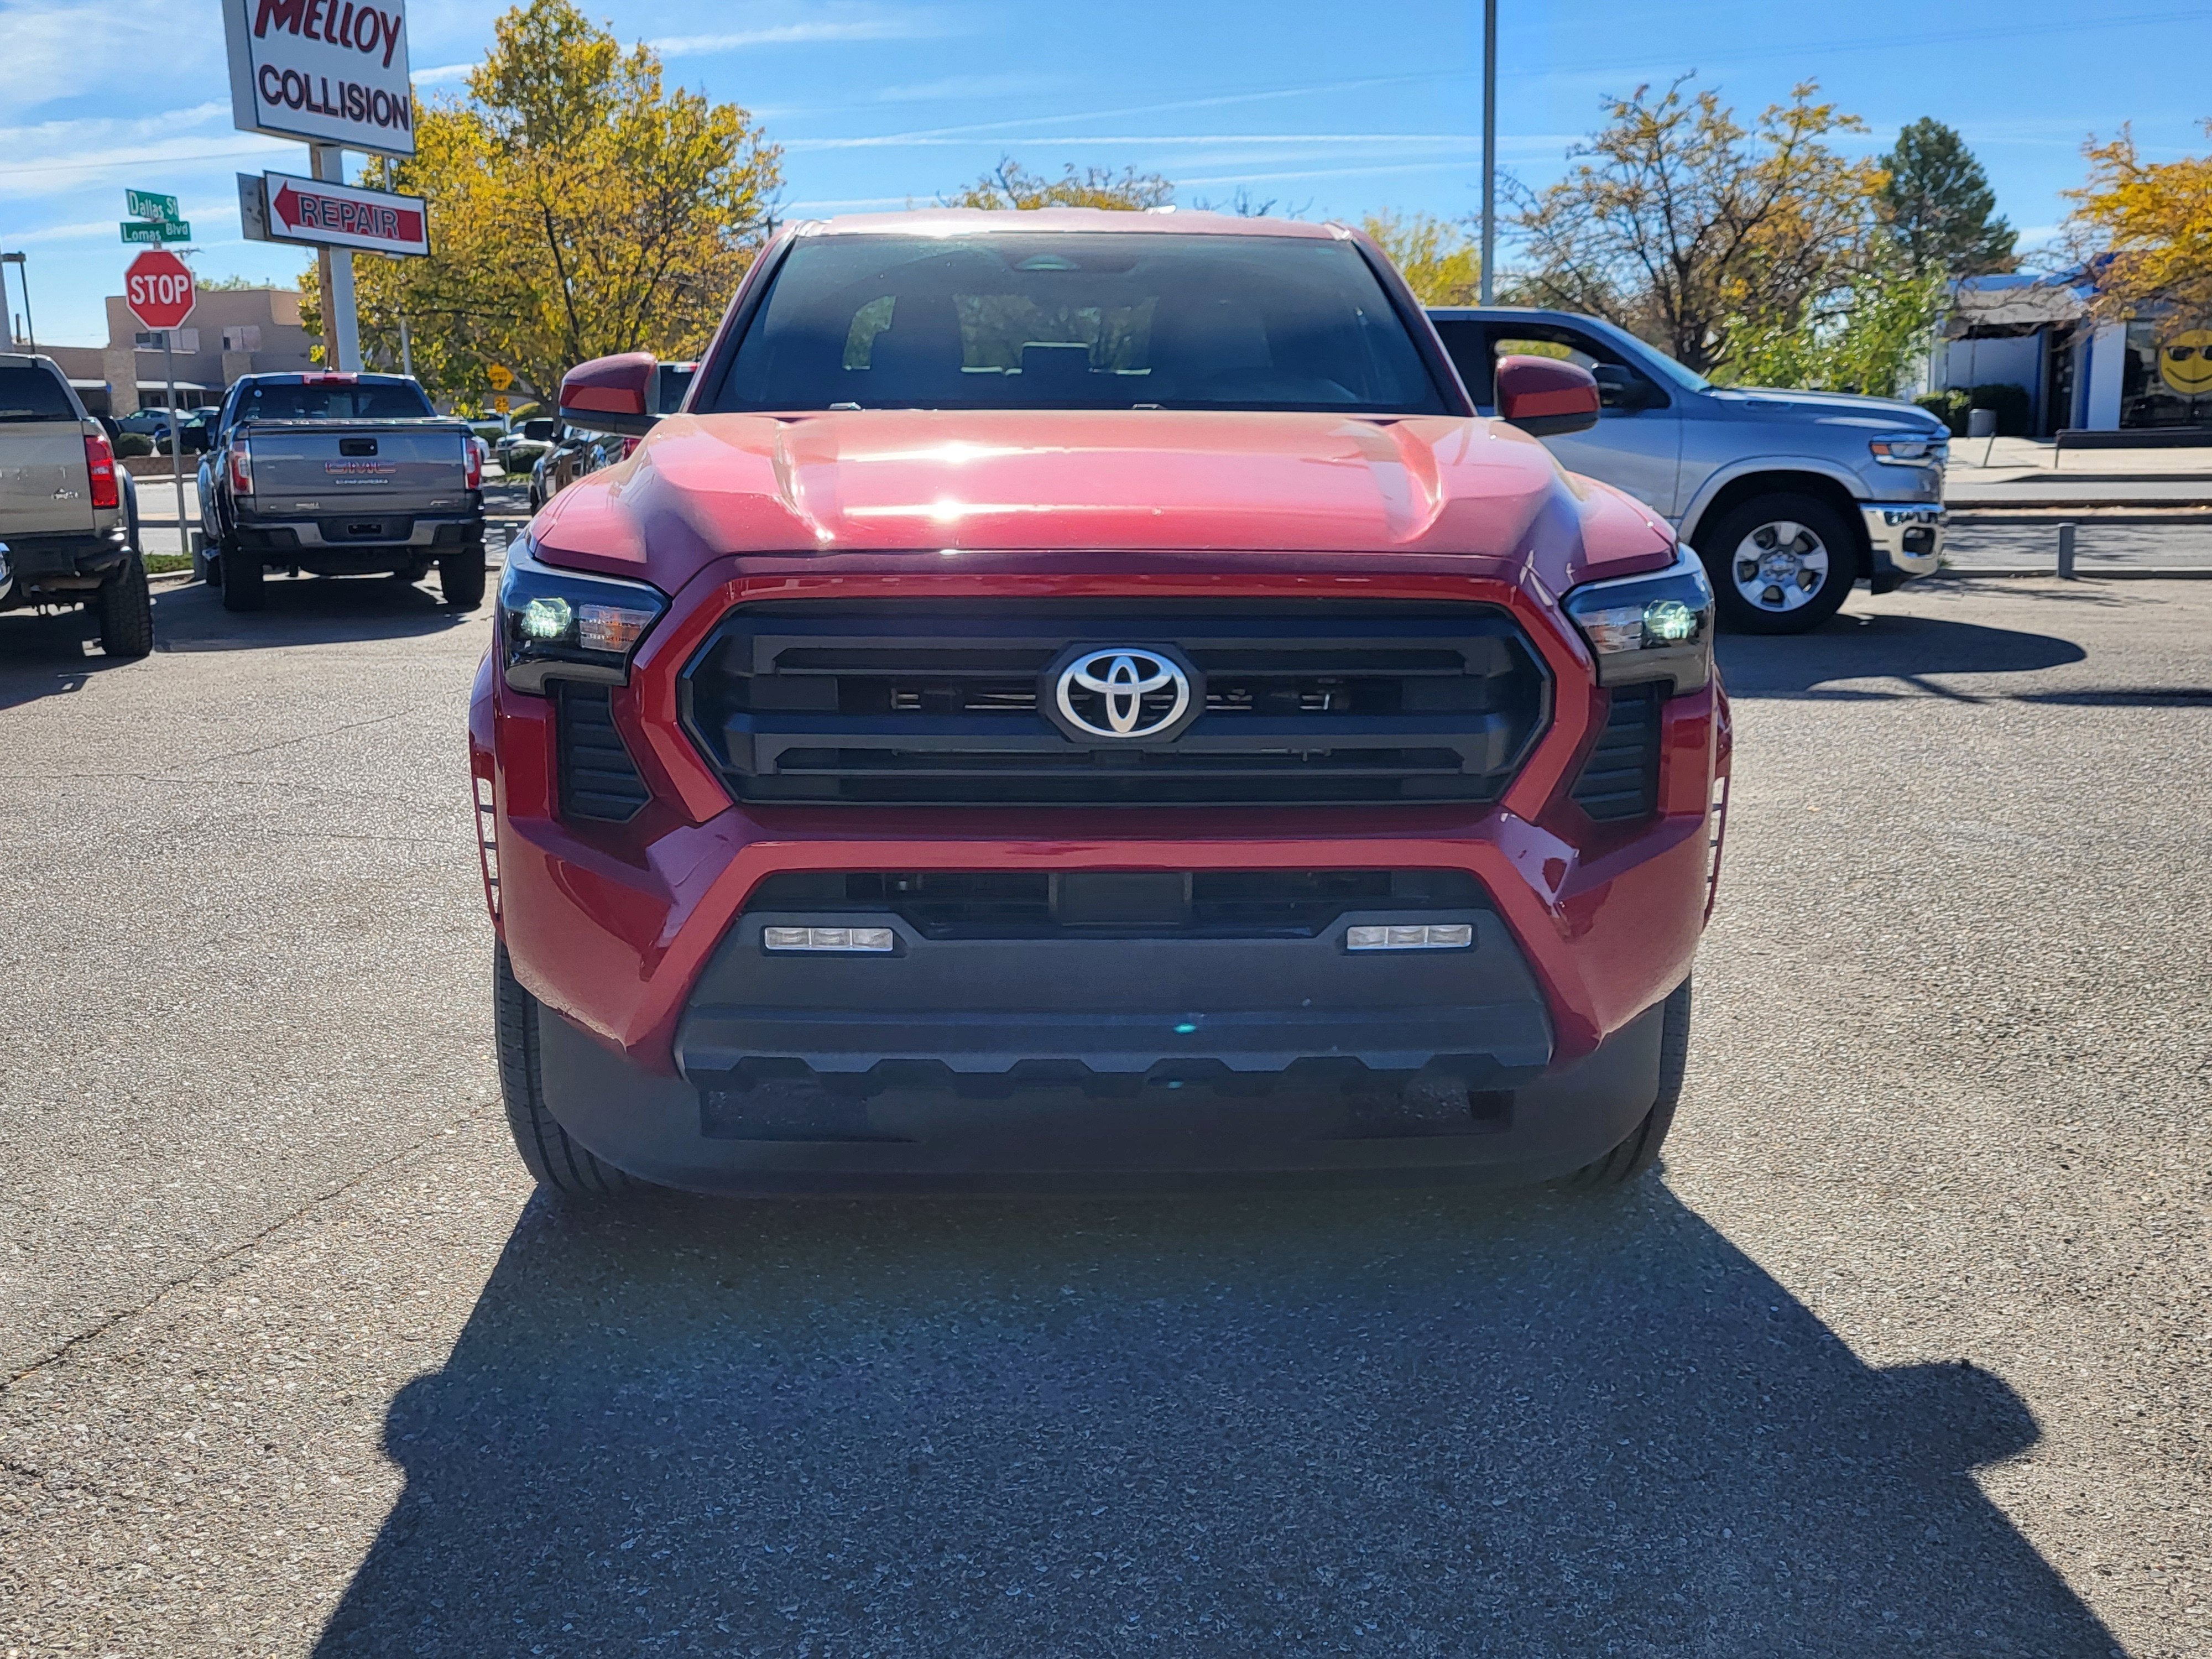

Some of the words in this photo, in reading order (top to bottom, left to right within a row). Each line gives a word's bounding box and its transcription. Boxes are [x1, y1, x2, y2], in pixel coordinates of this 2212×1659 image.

[254, 0, 401, 69] MELLOY
[259, 65, 409, 131] COLLISION
[129, 191, 164, 220] Dallas
[166, 197, 178, 216] St
[299, 196, 399, 237] REPAIR
[122, 224, 161, 242] Lomas
[166, 222, 188, 235] Blvd
[131, 274, 189, 305] STOP
[325, 461, 398, 474] GMC
